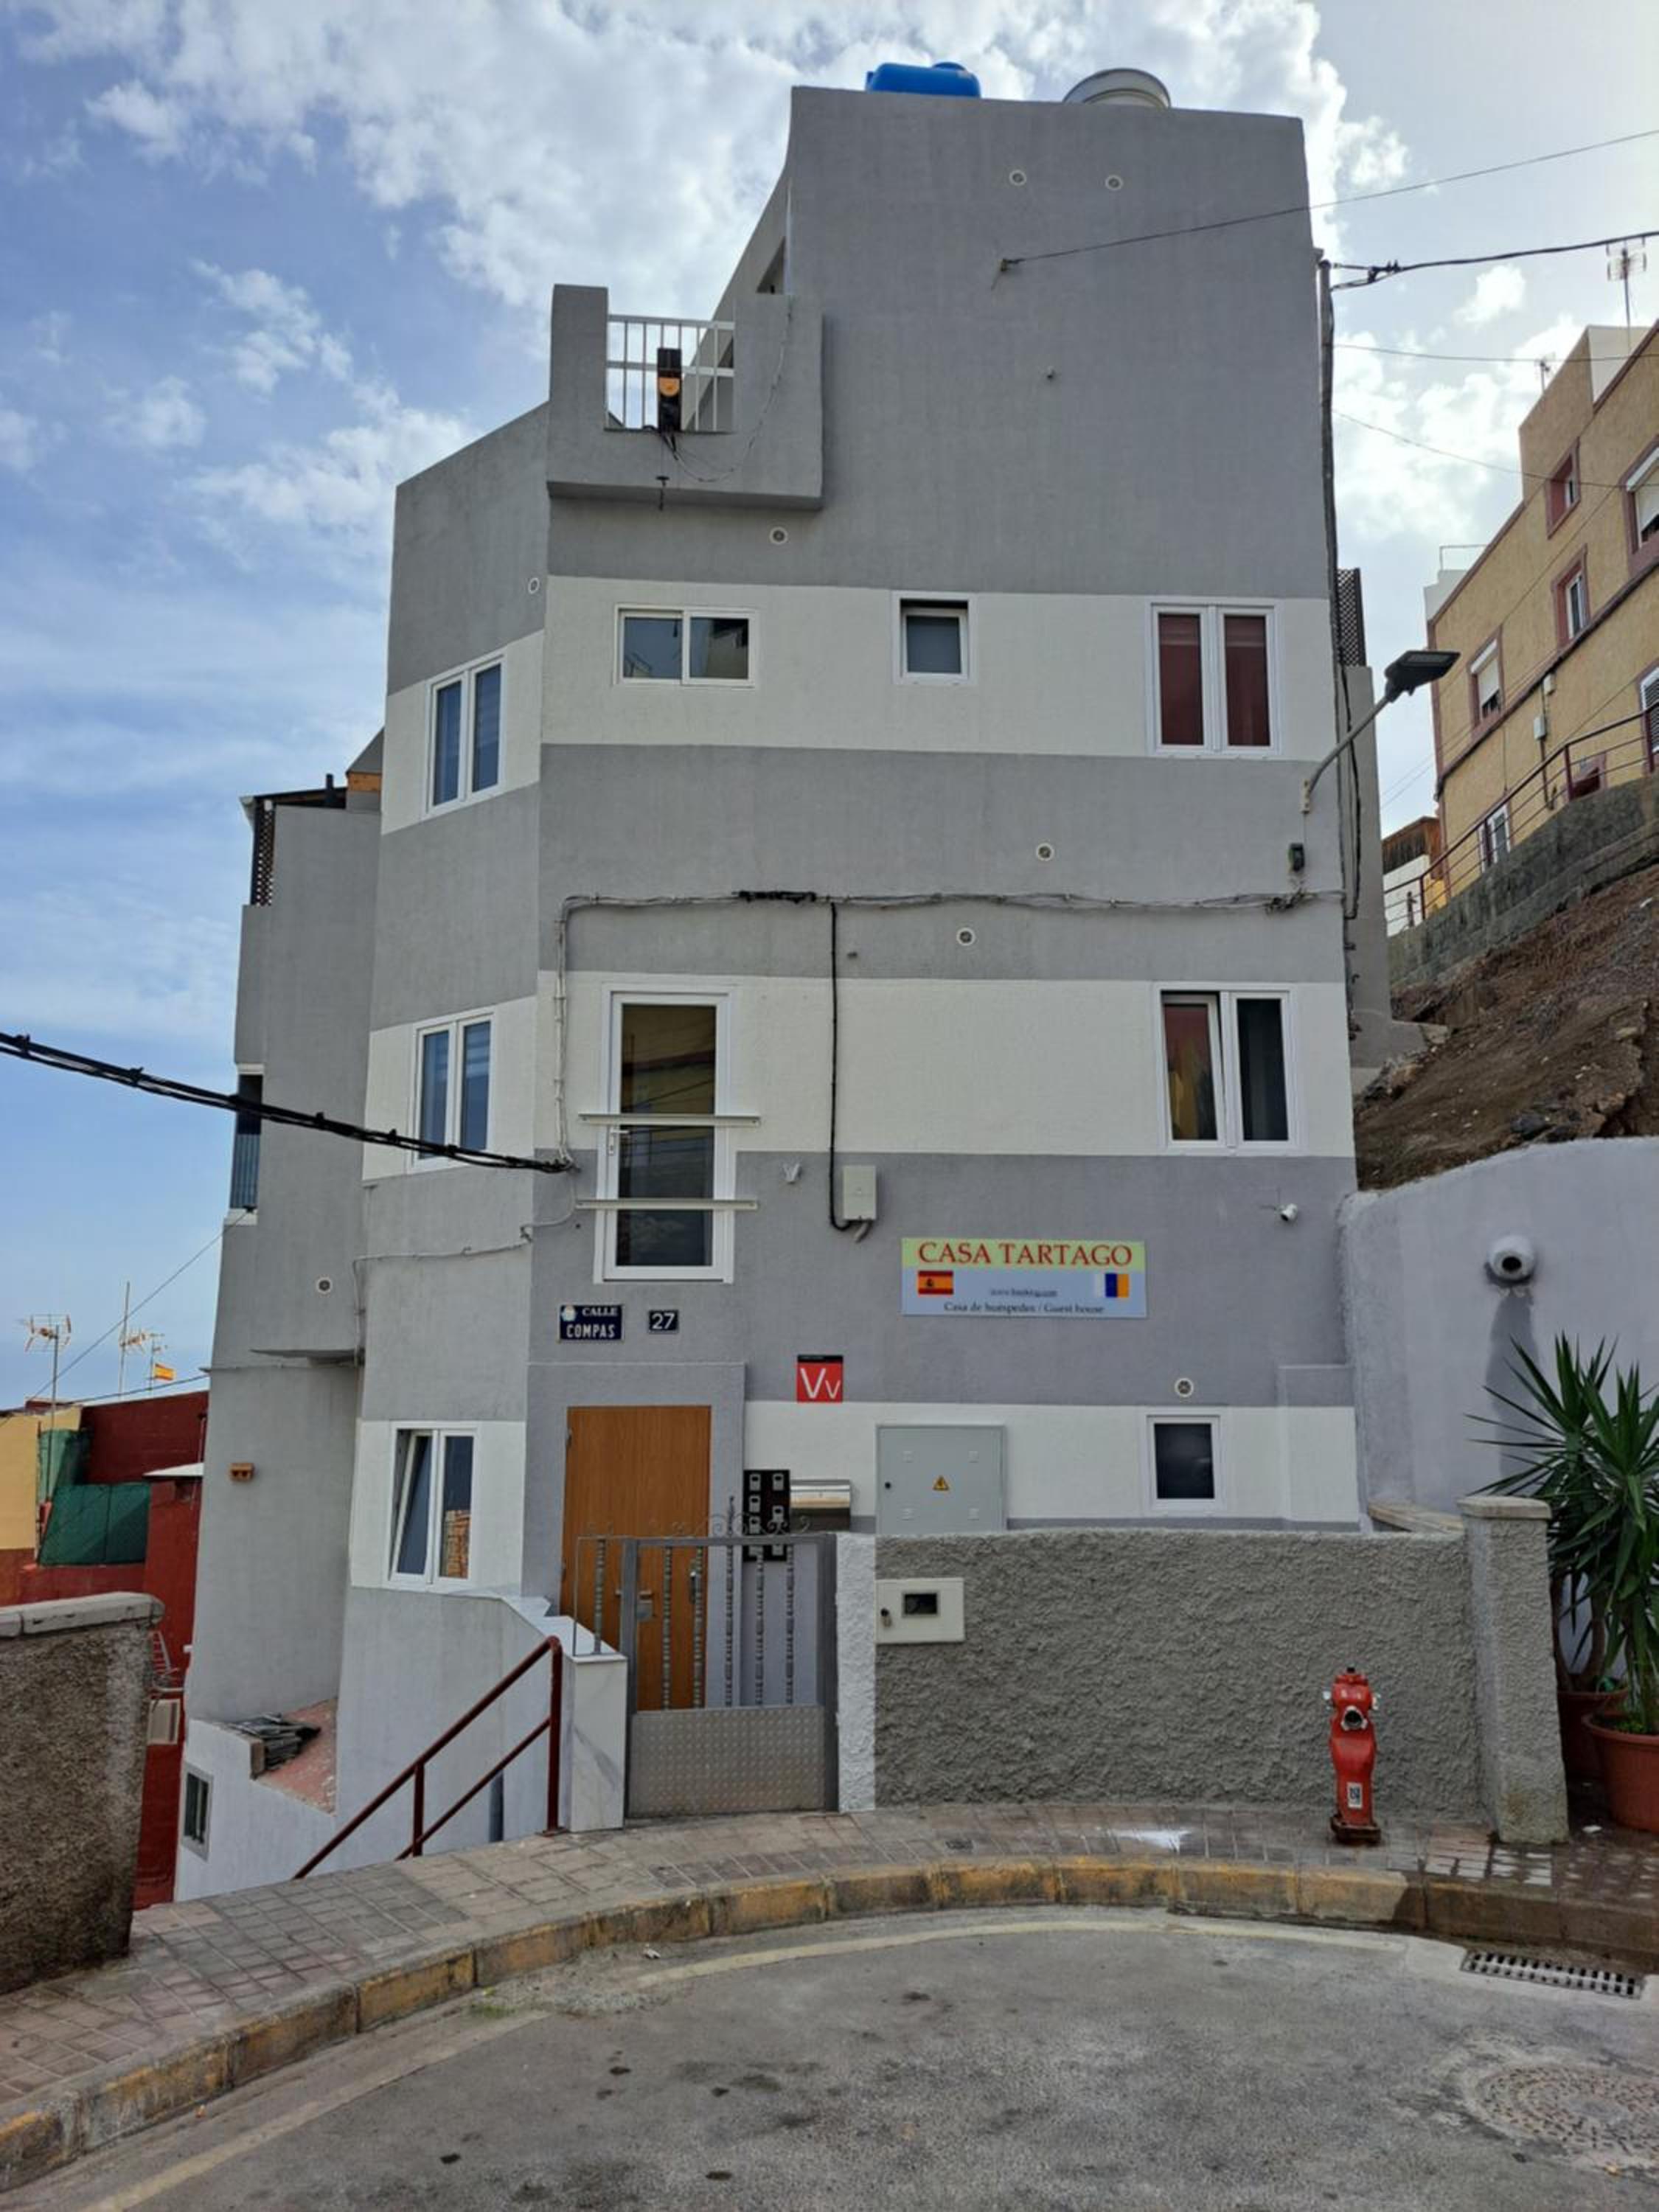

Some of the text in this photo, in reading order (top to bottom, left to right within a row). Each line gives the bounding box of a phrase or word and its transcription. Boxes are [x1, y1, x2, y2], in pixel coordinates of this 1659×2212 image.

[919, 1242, 1133, 1267] CASA TARTAGO
[582, 1307, 618, 1317] CALLE
[652, 1312, 675, 1329] 27
[566, 1324, 615, 1338] COMPAS
